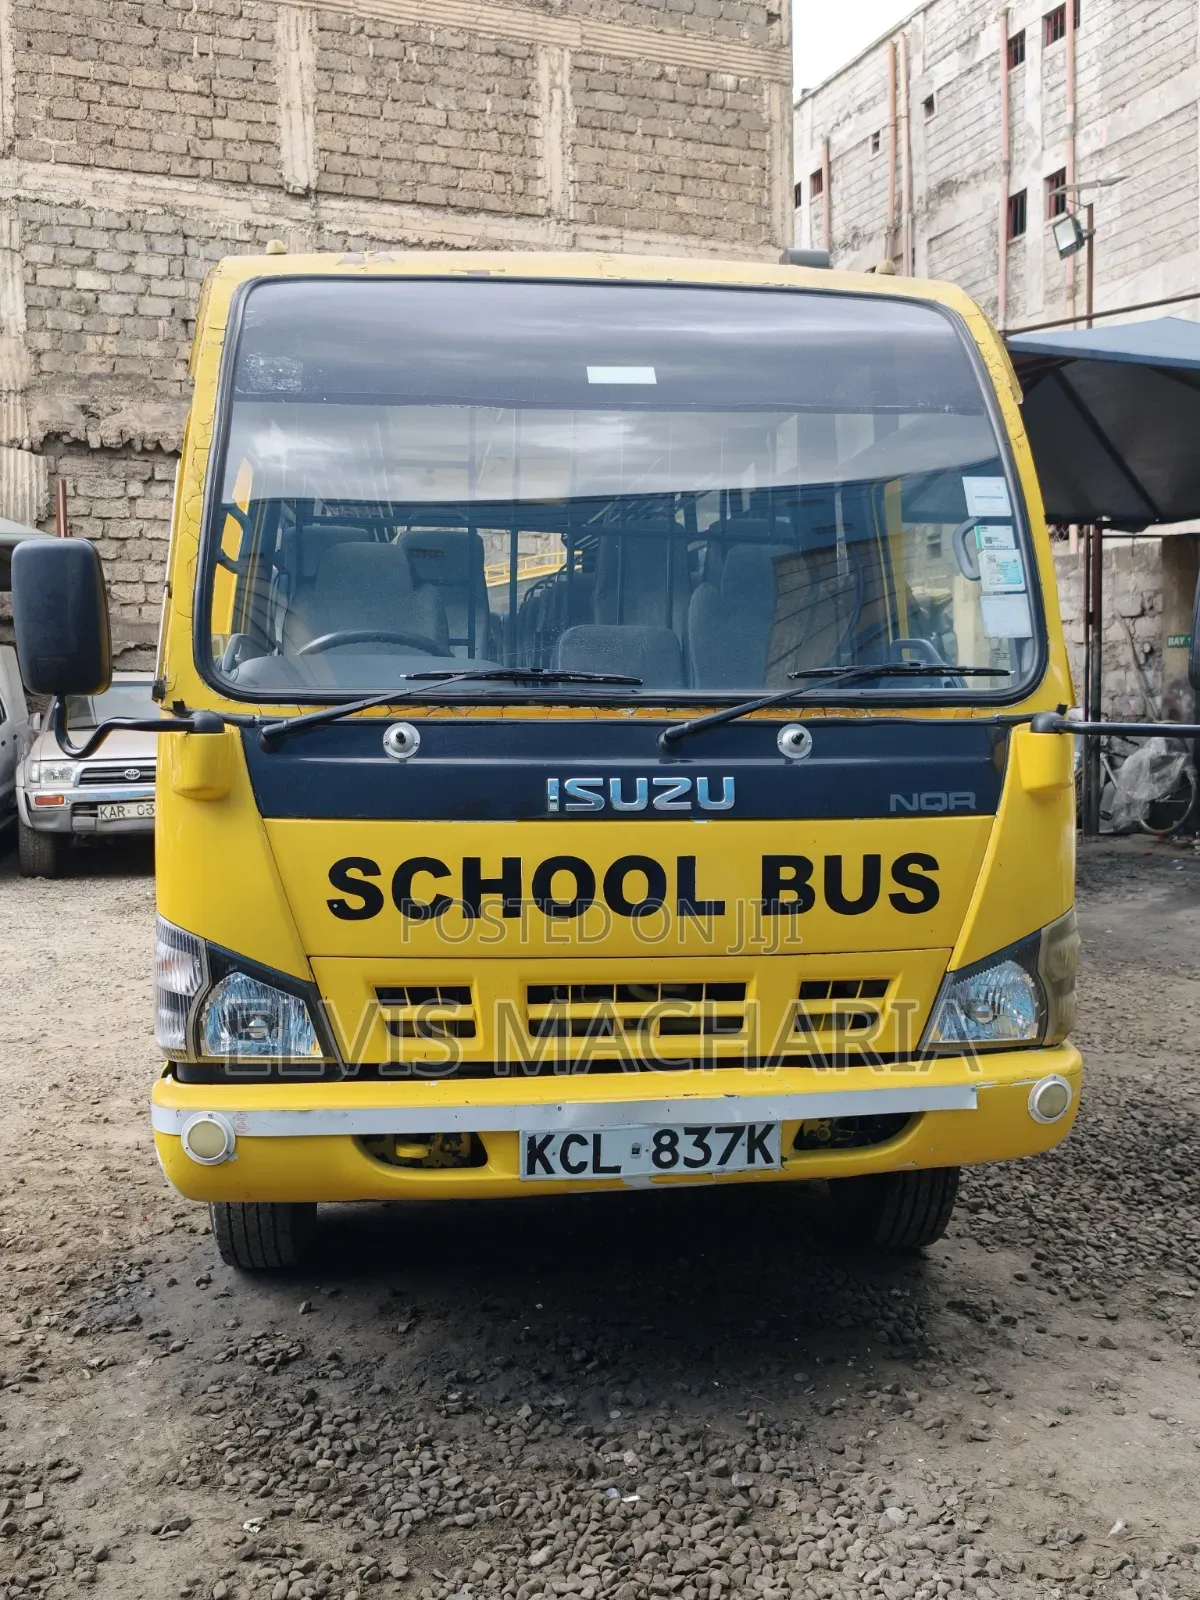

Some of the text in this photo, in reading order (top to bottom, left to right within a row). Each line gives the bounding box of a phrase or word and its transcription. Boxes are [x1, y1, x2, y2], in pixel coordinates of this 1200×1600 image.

[1168, 636, 1184, 645] BAY
[546, 776, 735, 812] ISUZU
[889, 791, 977, 812] NQR
[100, 804, 155, 819] KAR 03
[326, 852, 941, 921] SCHOOL BUS
[526, 1123, 775, 1175] KCL 837K
